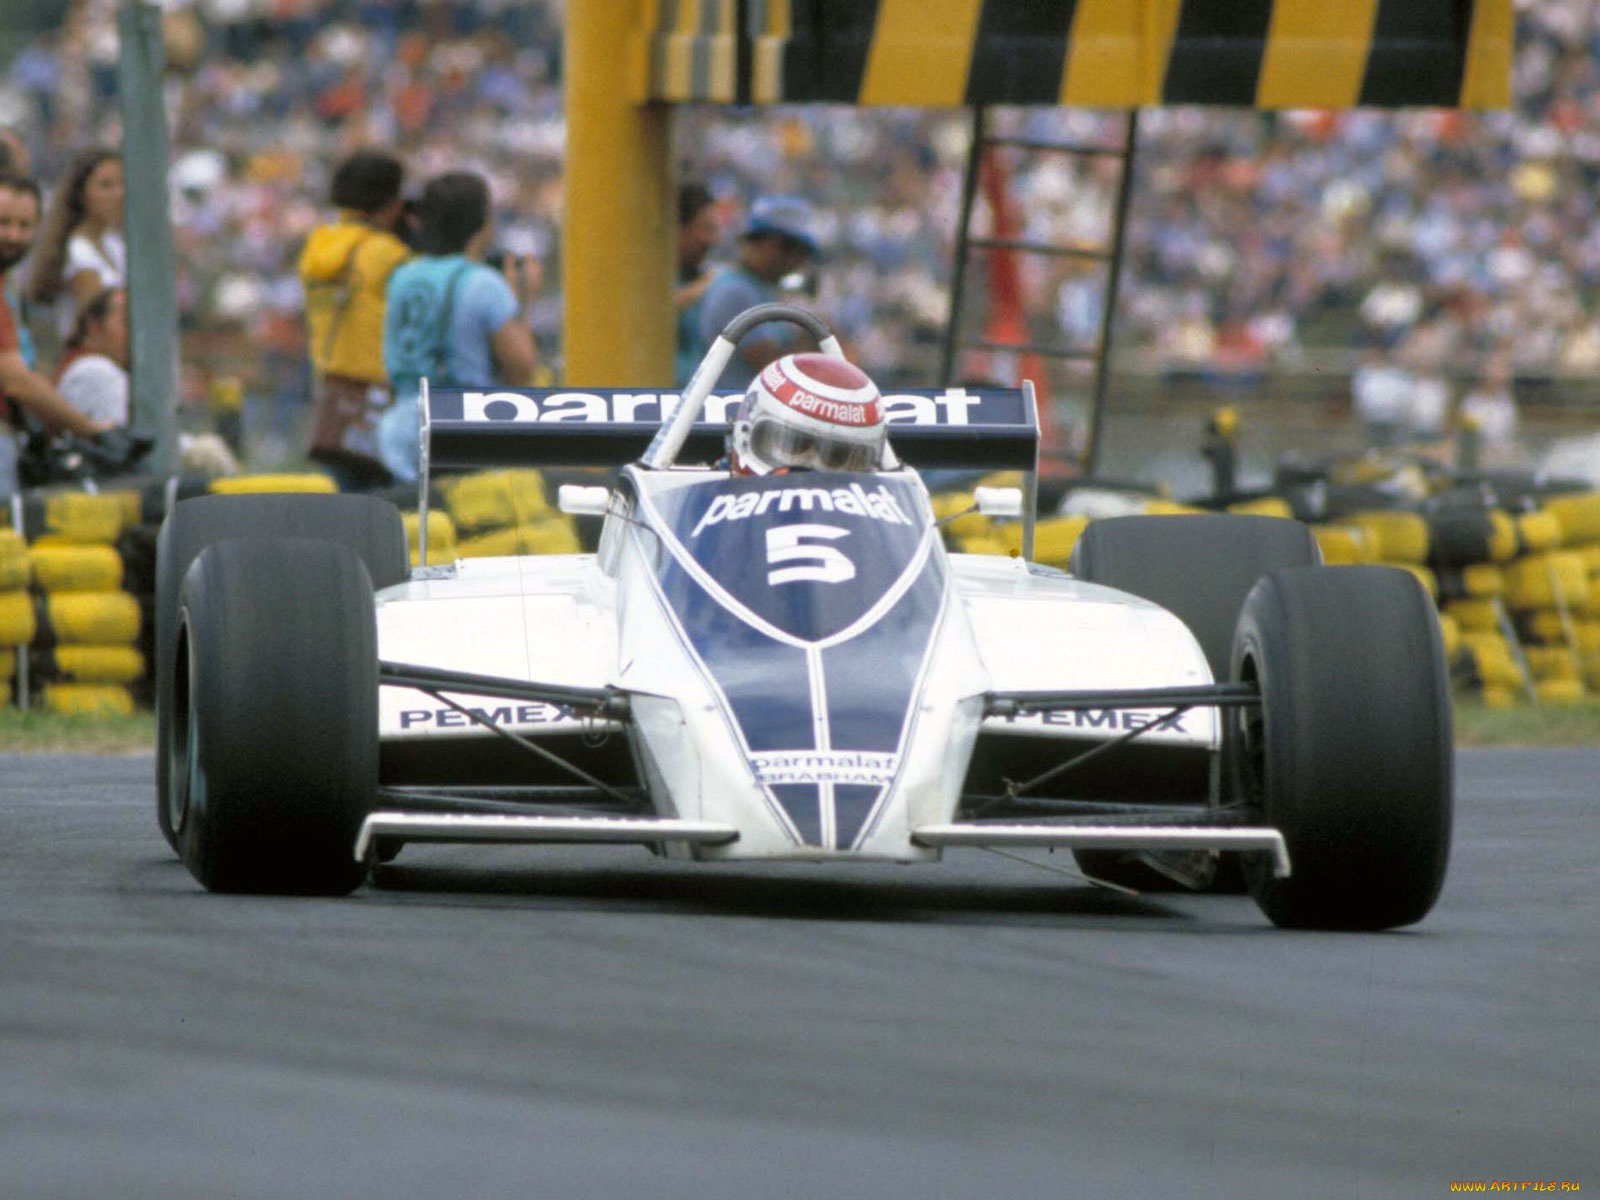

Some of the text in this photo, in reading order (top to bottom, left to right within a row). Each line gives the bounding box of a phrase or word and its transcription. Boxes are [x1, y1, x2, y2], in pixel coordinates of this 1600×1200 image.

[788, 391, 867, 424] parmalat
[691, 483, 913, 538] parmalat
[766, 524, 856, 586] 5
[750, 755, 896, 772] parmalat
[757, 772, 895, 784] BRABHAM
